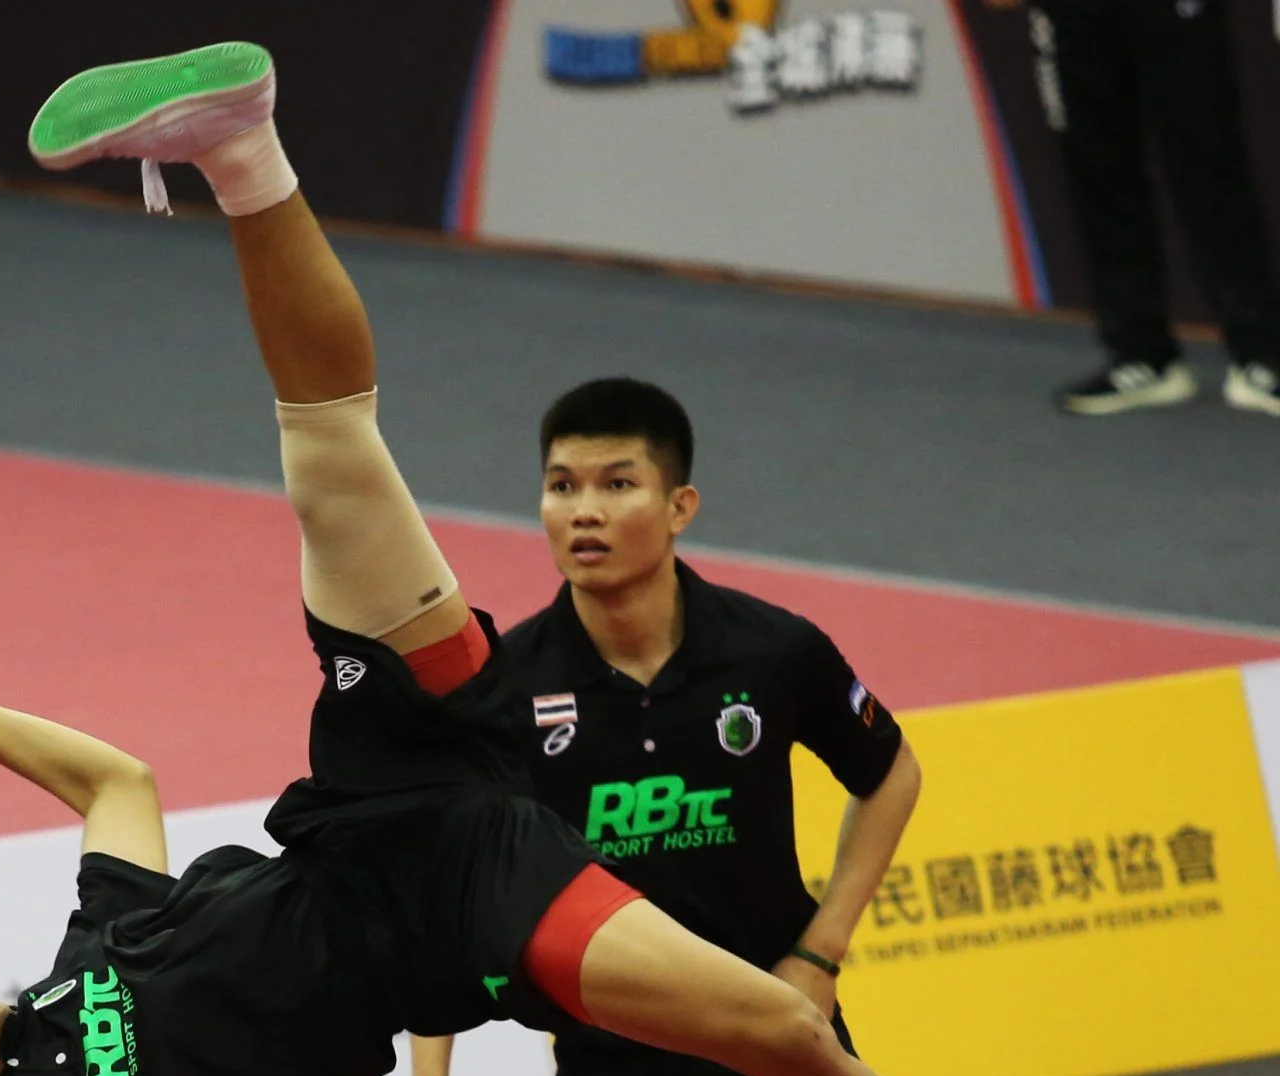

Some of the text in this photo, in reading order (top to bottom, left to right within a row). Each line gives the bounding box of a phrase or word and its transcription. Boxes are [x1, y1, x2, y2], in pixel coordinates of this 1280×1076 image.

[662, 826, 737, 851] HOSTEL
[812, 822, 1218, 928] 民國藤球協會
